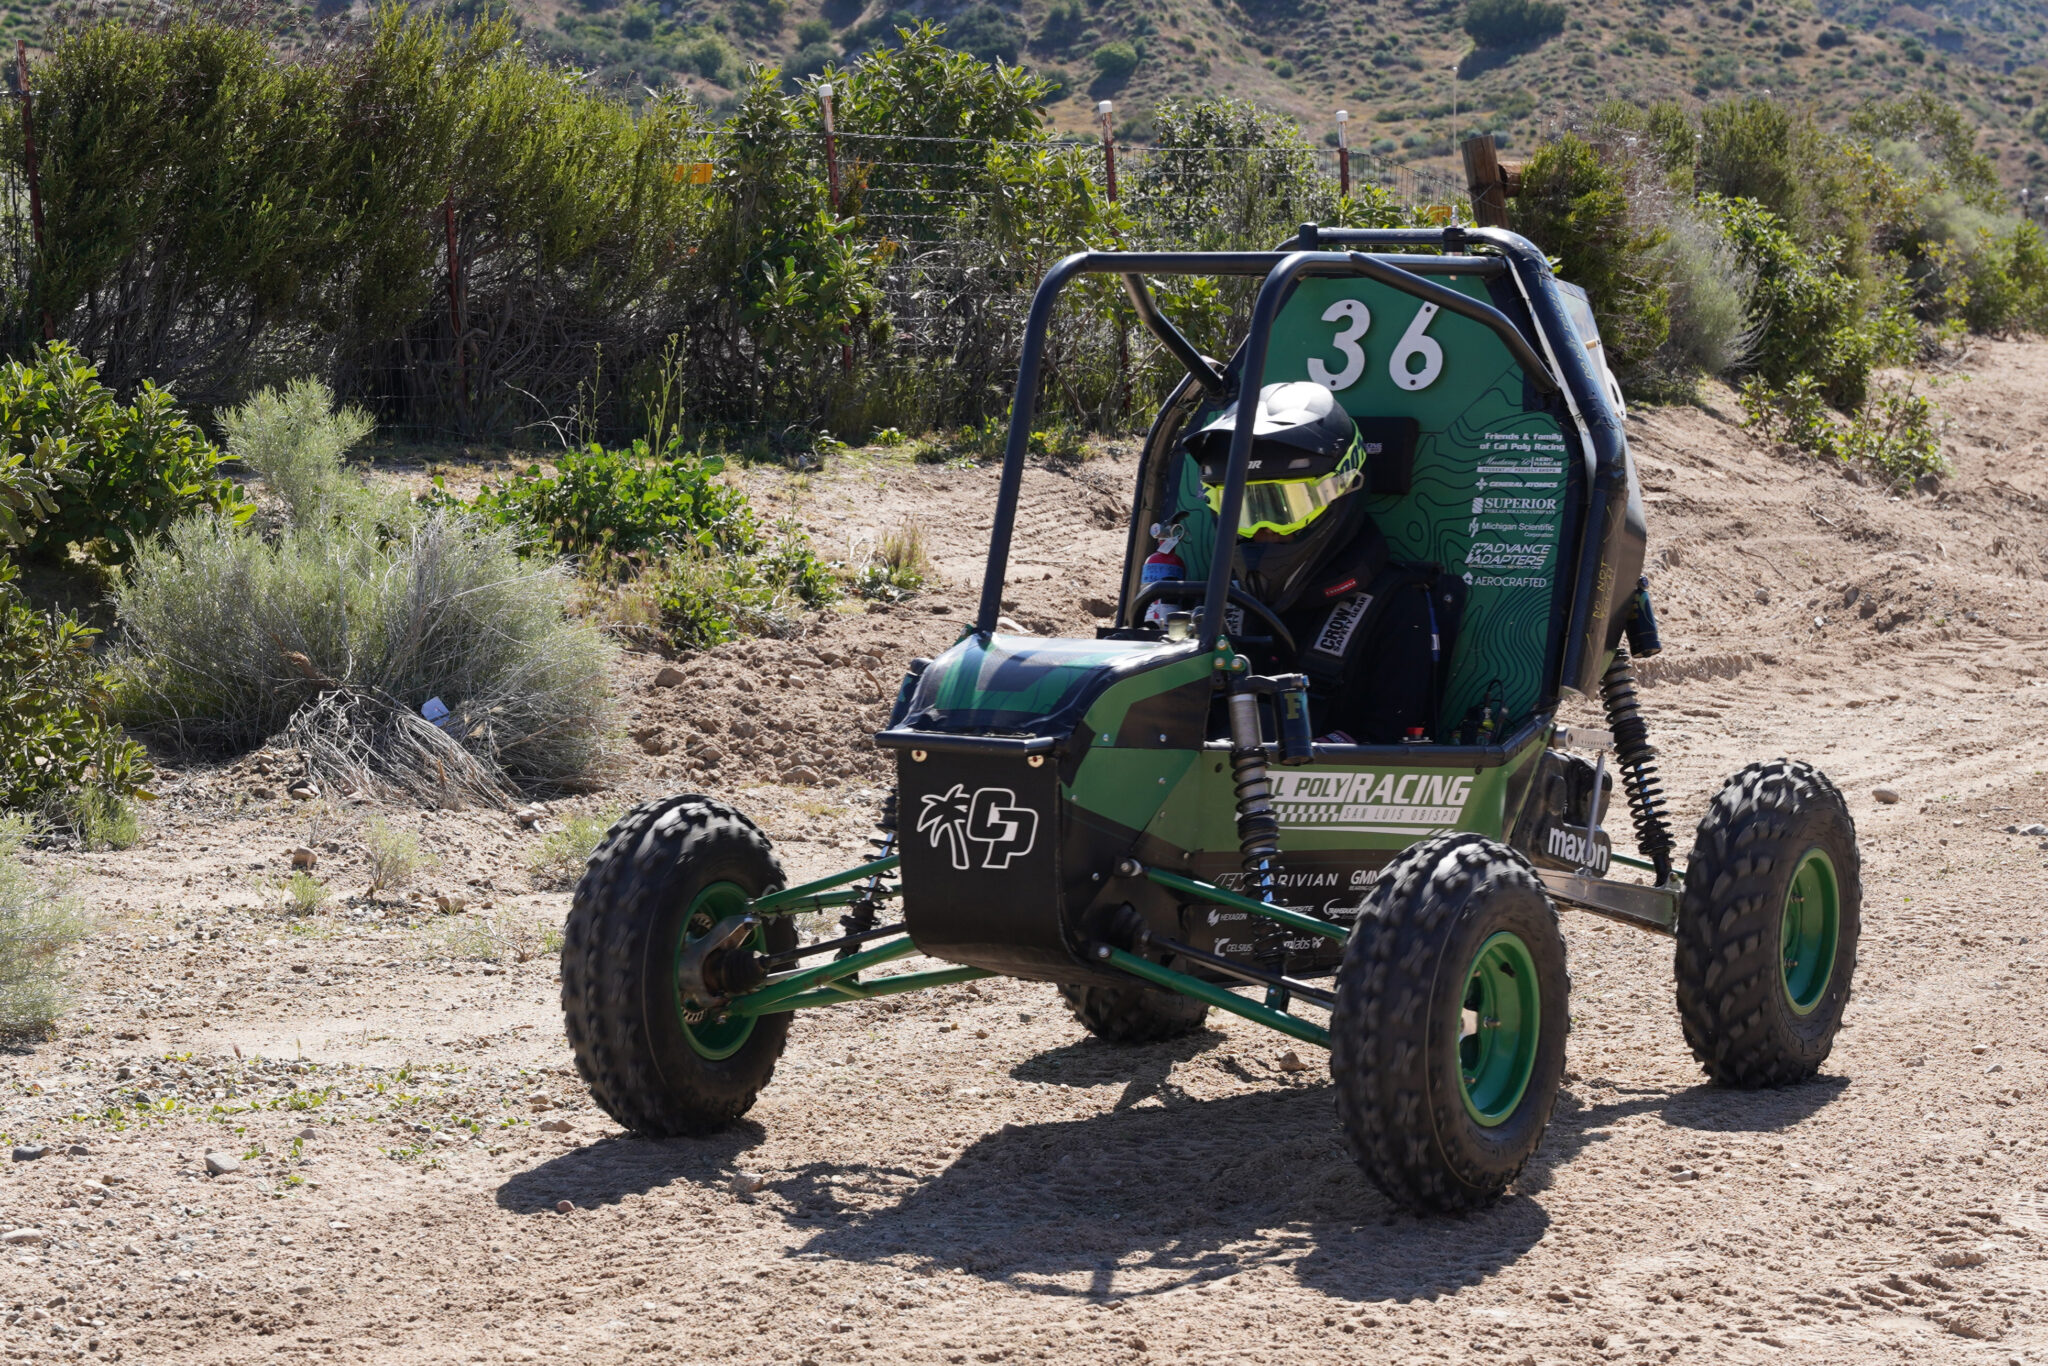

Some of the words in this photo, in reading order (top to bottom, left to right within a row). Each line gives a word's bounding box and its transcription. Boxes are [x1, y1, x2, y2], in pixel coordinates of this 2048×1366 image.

[1307, 299, 1443, 391] 36
[1485, 432, 1519, 440] Friends
[1533, 433, 1562, 442] family
[1480, 442, 1490, 450] of
[1511, 443, 1531, 452] Poly
[1534, 443, 1565, 452] Racing
[1484, 498, 1556, 509] SUPERIOR
[1482, 522, 1517, 531] Michigan
[1519, 523, 1555, 531] Scientific
[1482, 544, 1552, 554] ADVANCE
[1471, 554, 1547, 566] ADAPTERS
[1475, 577, 1547, 587] AEROCRAFTED
[1321, 608, 1351, 649] CROW
[1333, 618, 1353, 652] SAFETY
[1351, 597, 1367, 618] GEAR
[1294, 776, 1349, 798] POLY
[1345, 773, 1474, 806] RACING
[1343, 808, 1366, 820] SAN
[1374, 808, 1402, 820] LUIS
[1411, 808, 1457, 821] OBISPO
[1277, 873, 1339, 887] RIVIAN
[1220, 913, 1248, 921] HEXAGON
[1226, 943, 1253, 953] CELSIUS
